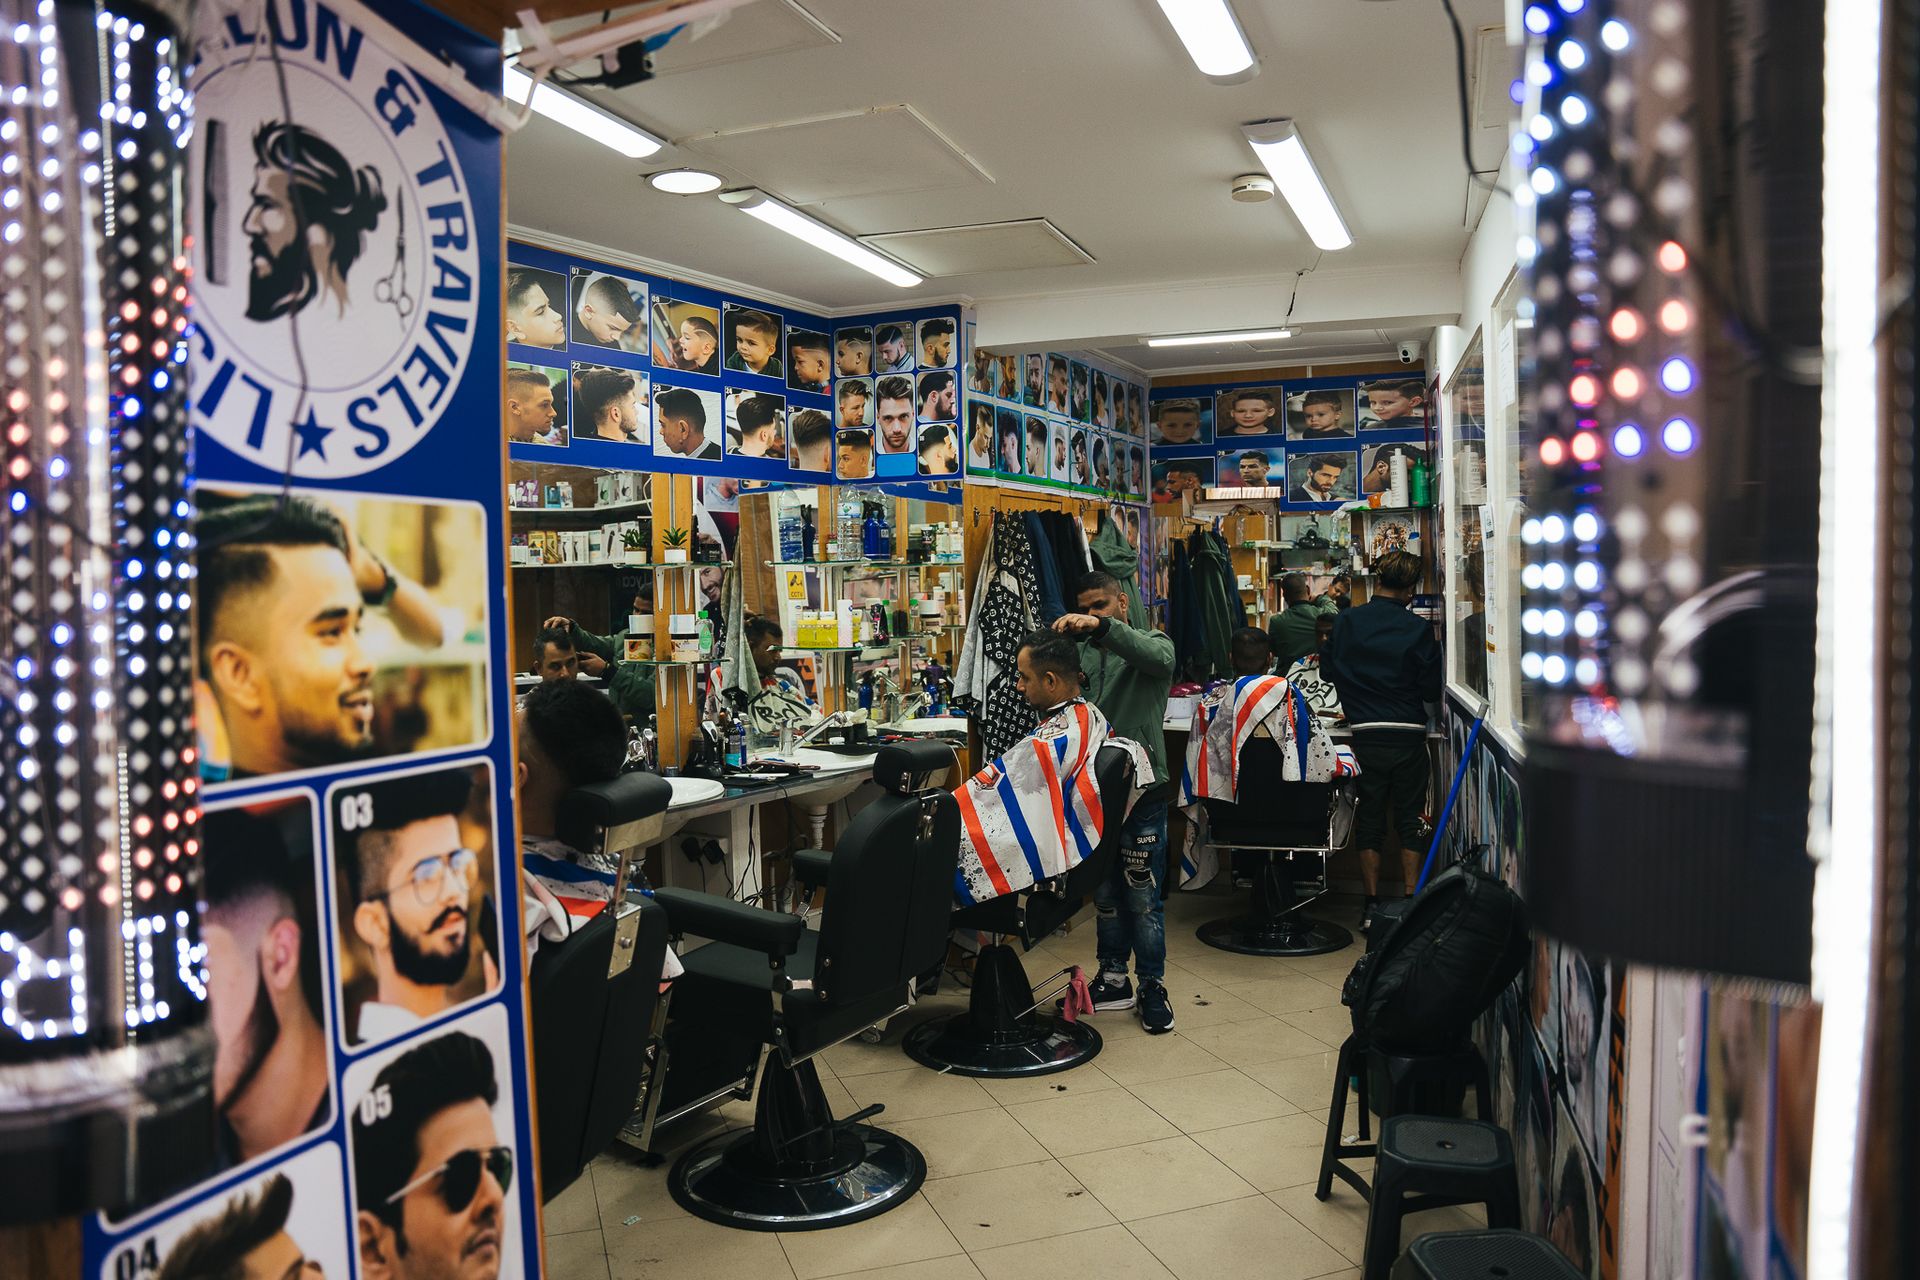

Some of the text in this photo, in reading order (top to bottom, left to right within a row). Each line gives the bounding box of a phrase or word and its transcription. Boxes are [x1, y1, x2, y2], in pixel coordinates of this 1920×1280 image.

[375, 68, 421, 136] &
[571, 267, 580, 275] 07
[347, 140, 472, 459] TRAVELS
[572, 361, 581, 370] 22
[652, 383, 662, 392] 23
[340, 792, 374, 831] 03
[1136, 836, 1156, 844] SUPER
[360, 1084, 392, 1126] 05
[116, 1236, 158, 1280] 04
